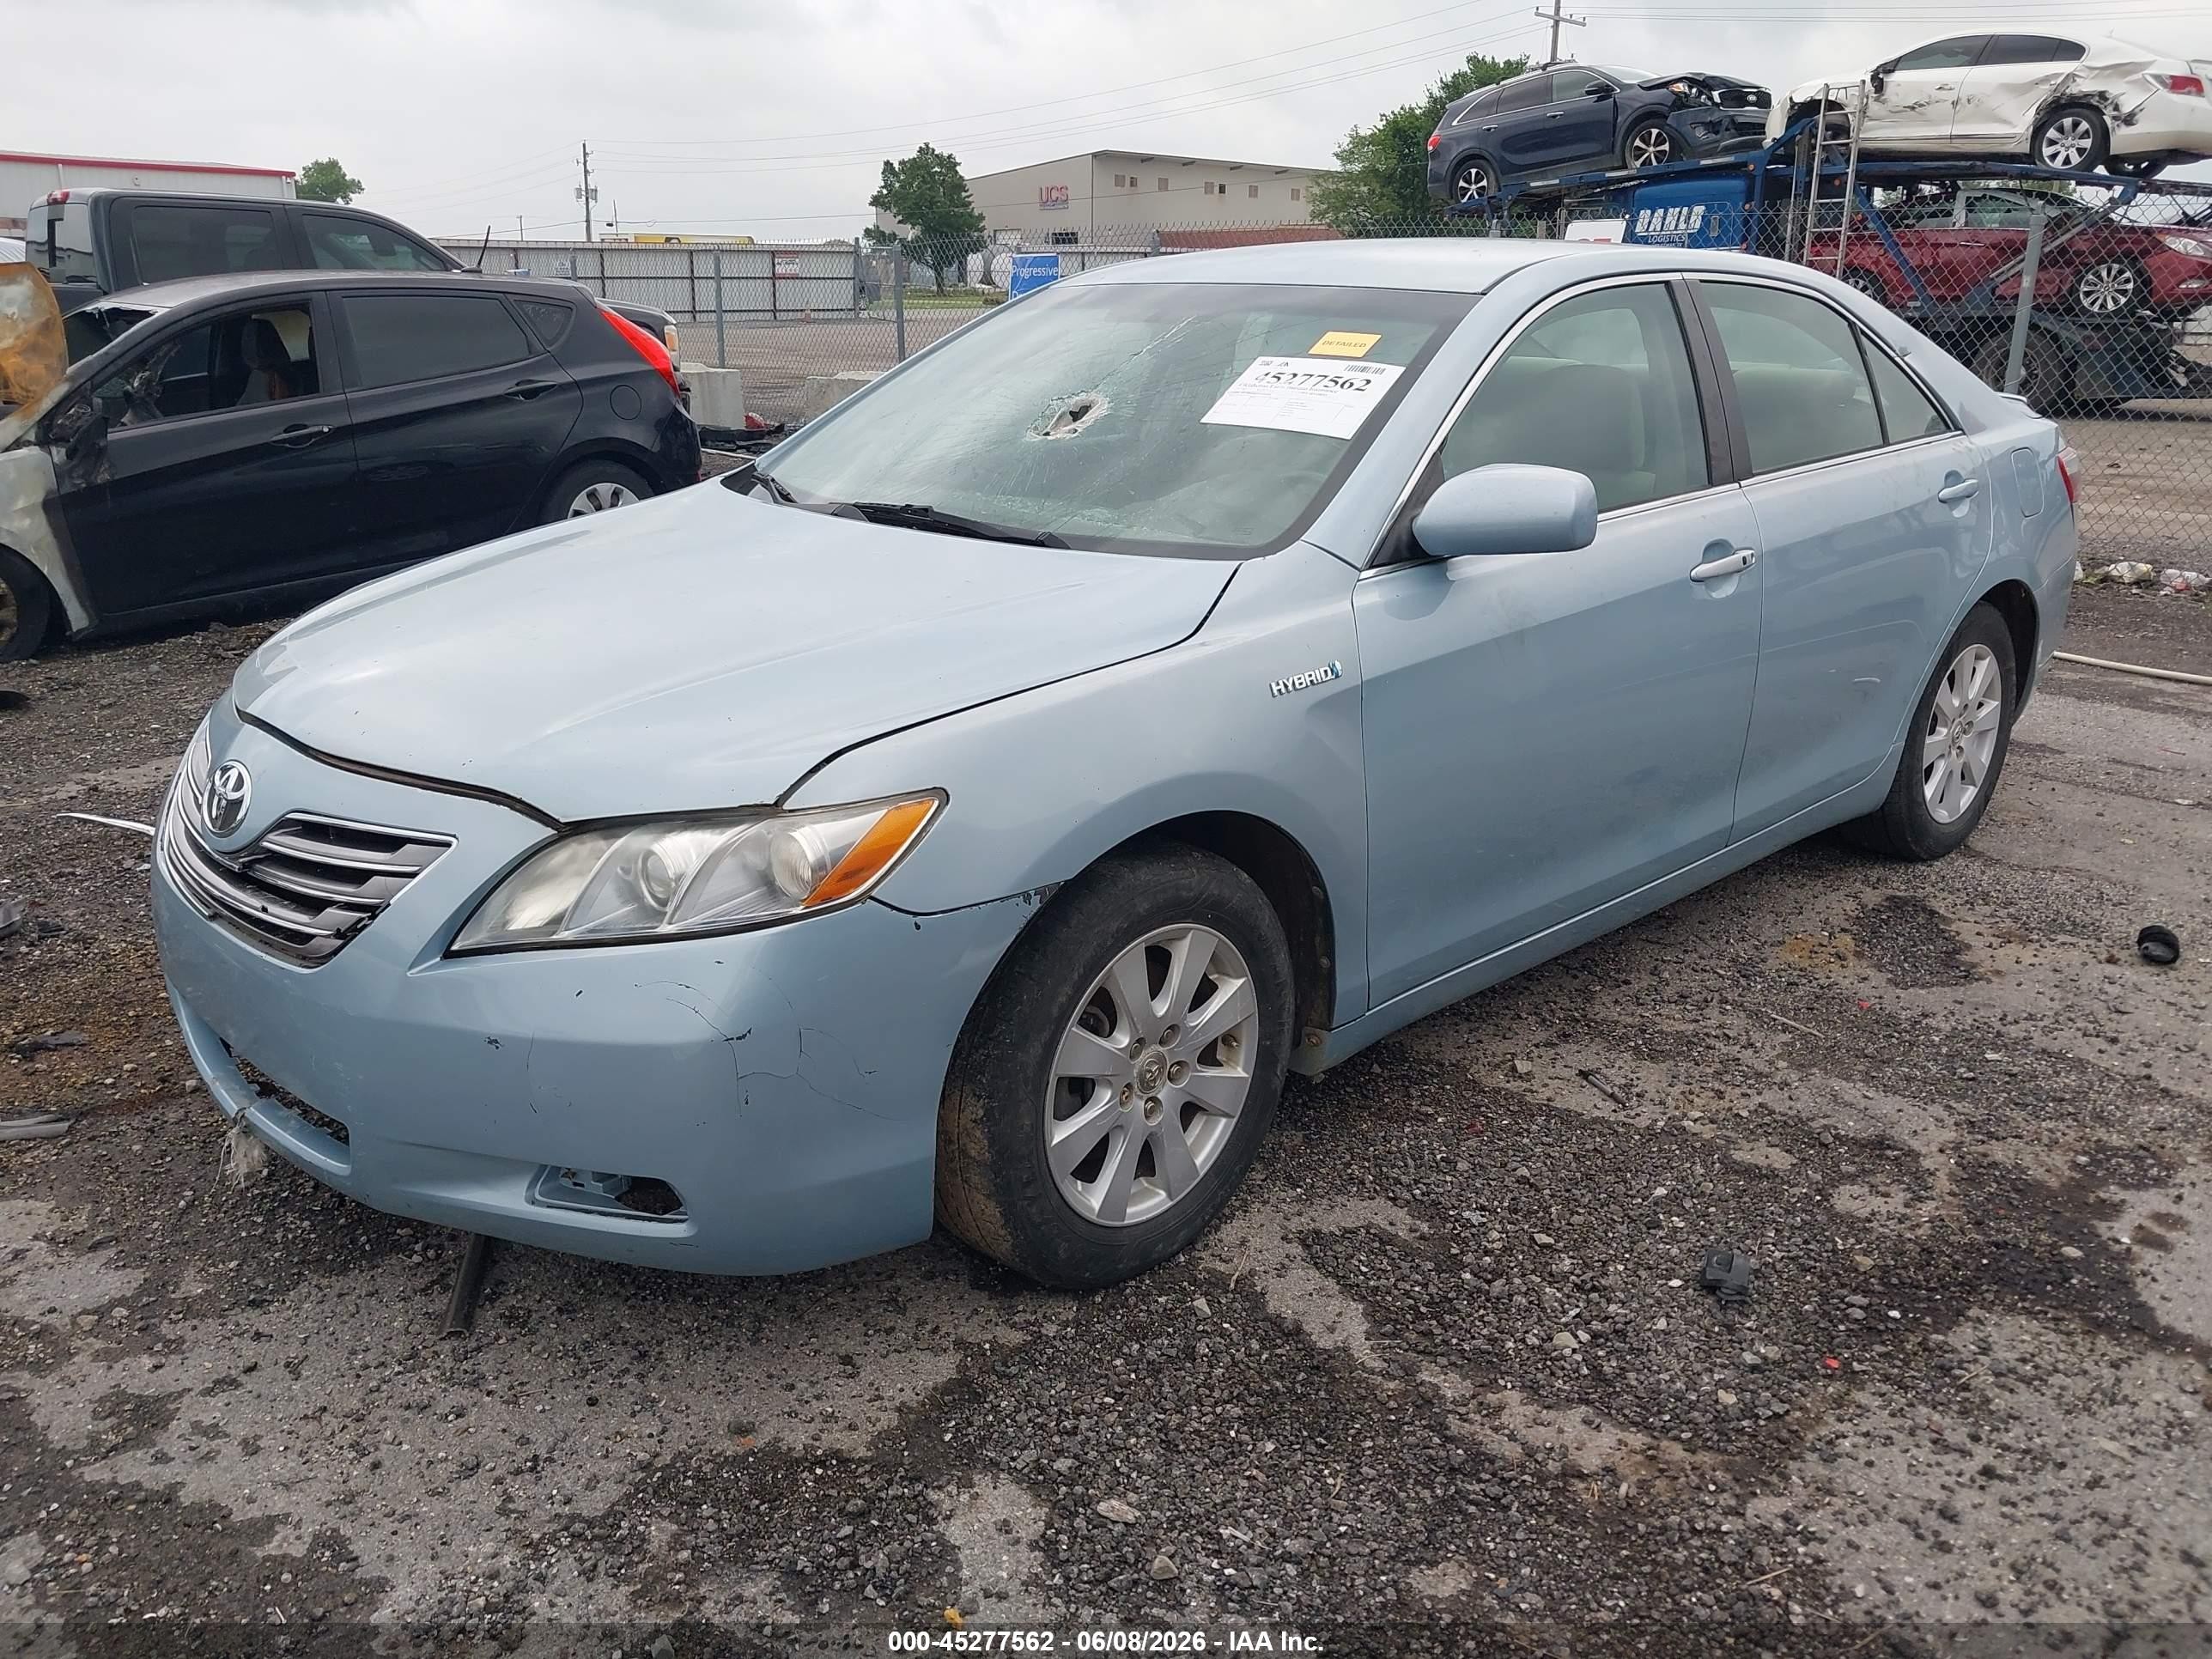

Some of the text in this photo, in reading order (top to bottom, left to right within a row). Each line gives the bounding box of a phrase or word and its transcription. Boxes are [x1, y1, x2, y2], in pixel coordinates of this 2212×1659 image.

[1040, 185, 1069, 204] UCS
[1648, 234, 1686, 243] LOGISTICS
[1012, 264, 1059, 279] Progressive
[1322, 340, 1367, 349] DETAILED
[1255, 371, 1372, 392] 45277562
[1270, 667, 1334, 697] HYBRID
